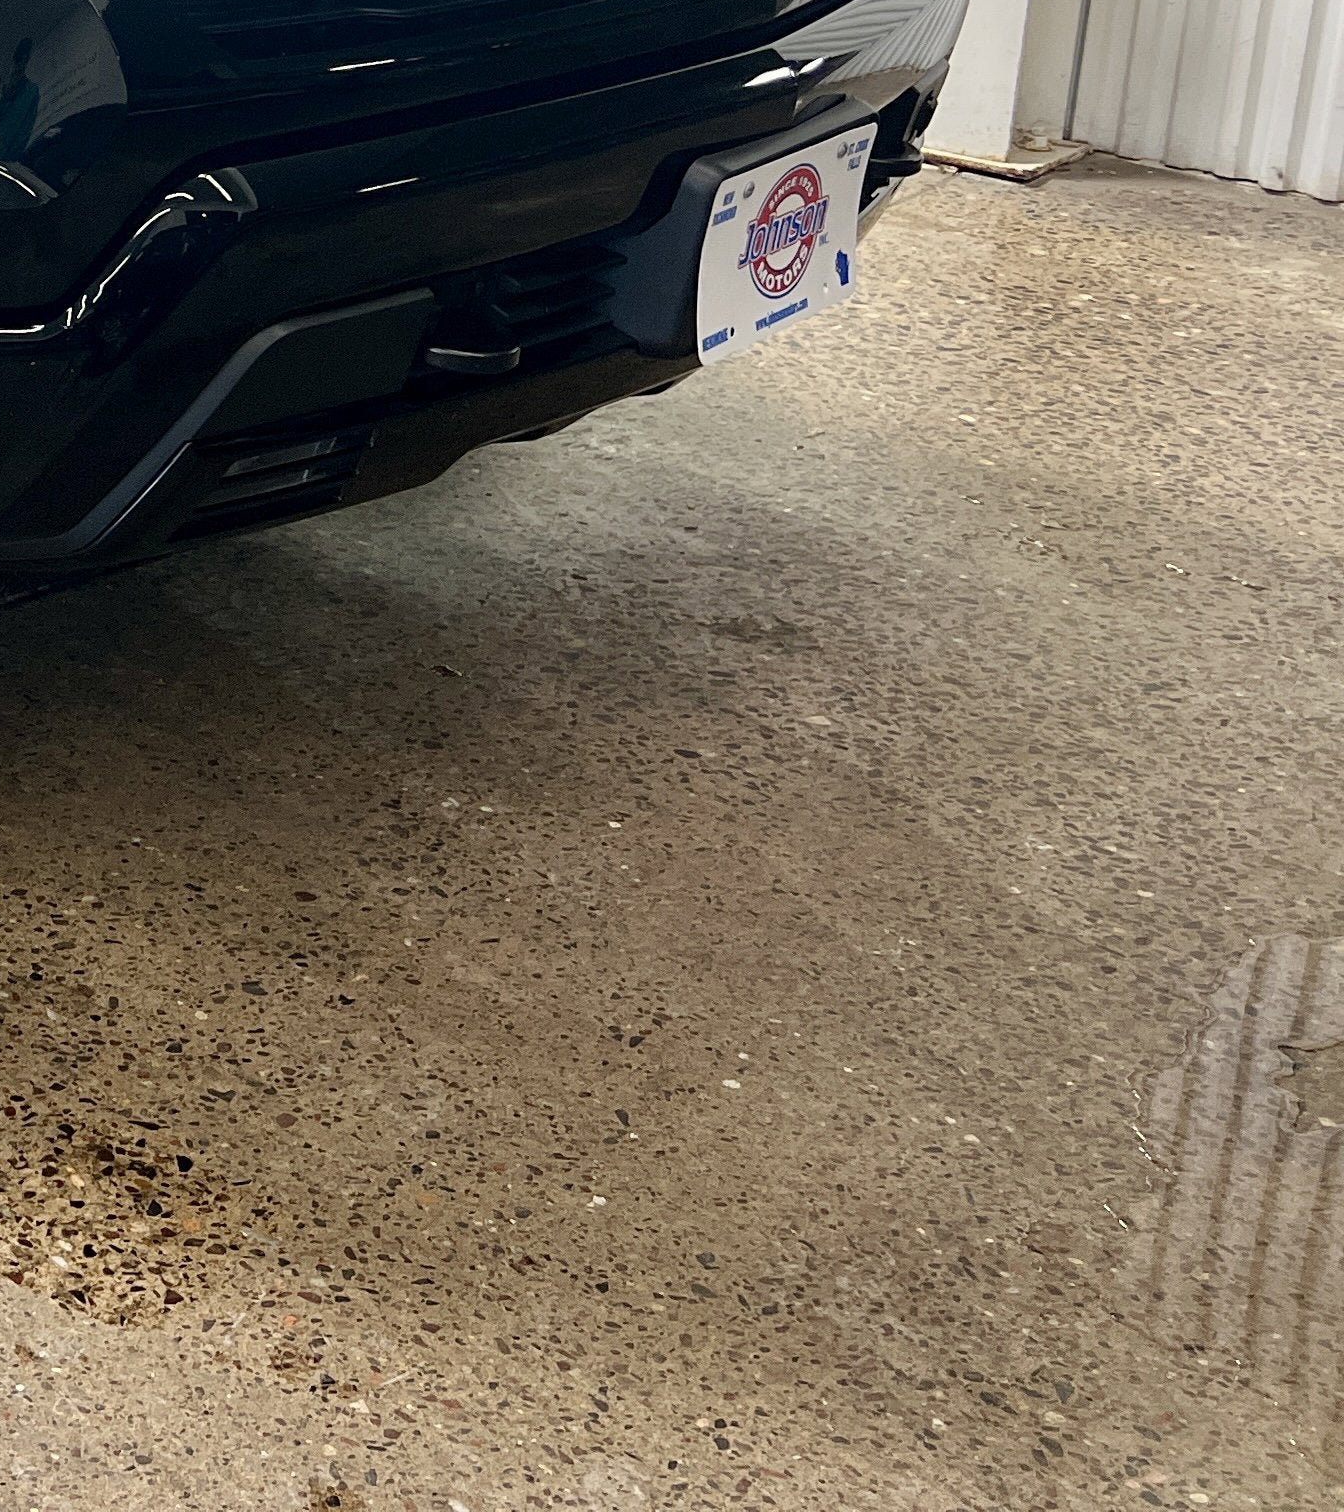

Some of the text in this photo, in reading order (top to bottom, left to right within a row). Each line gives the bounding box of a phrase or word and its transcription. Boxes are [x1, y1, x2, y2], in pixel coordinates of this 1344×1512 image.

[769, 175, 798, 210] SINCE
[739, 196, 828, 267] Johnson
[756, 244, 809, 291] MOTORS
